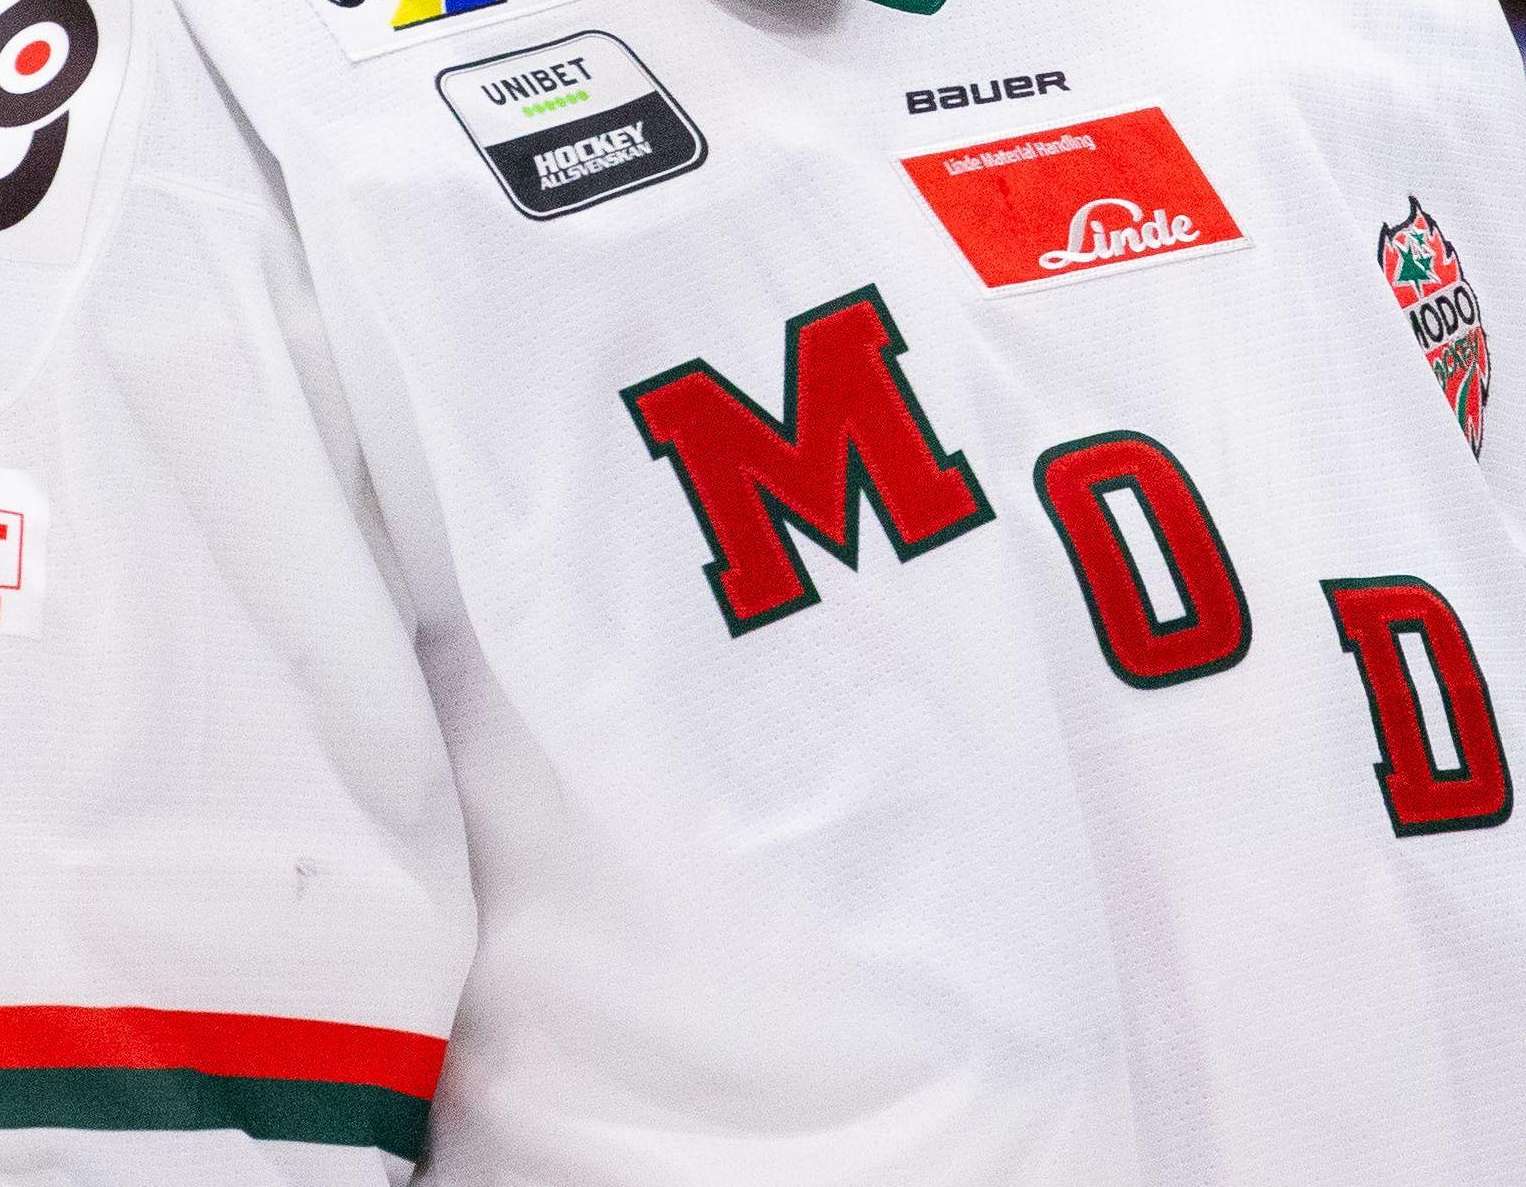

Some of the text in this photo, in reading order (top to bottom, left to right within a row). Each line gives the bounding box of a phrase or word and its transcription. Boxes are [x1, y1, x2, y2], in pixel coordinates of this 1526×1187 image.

[481, 57, 591, 105] UNIBET
[905, 71, 1071, 114] BAUER
[533, 120, 644, 177] HOCKEY
[541, 141, 652, 190] ALLSVENSKAN
[1039, 198, 1200, 270] Linde
